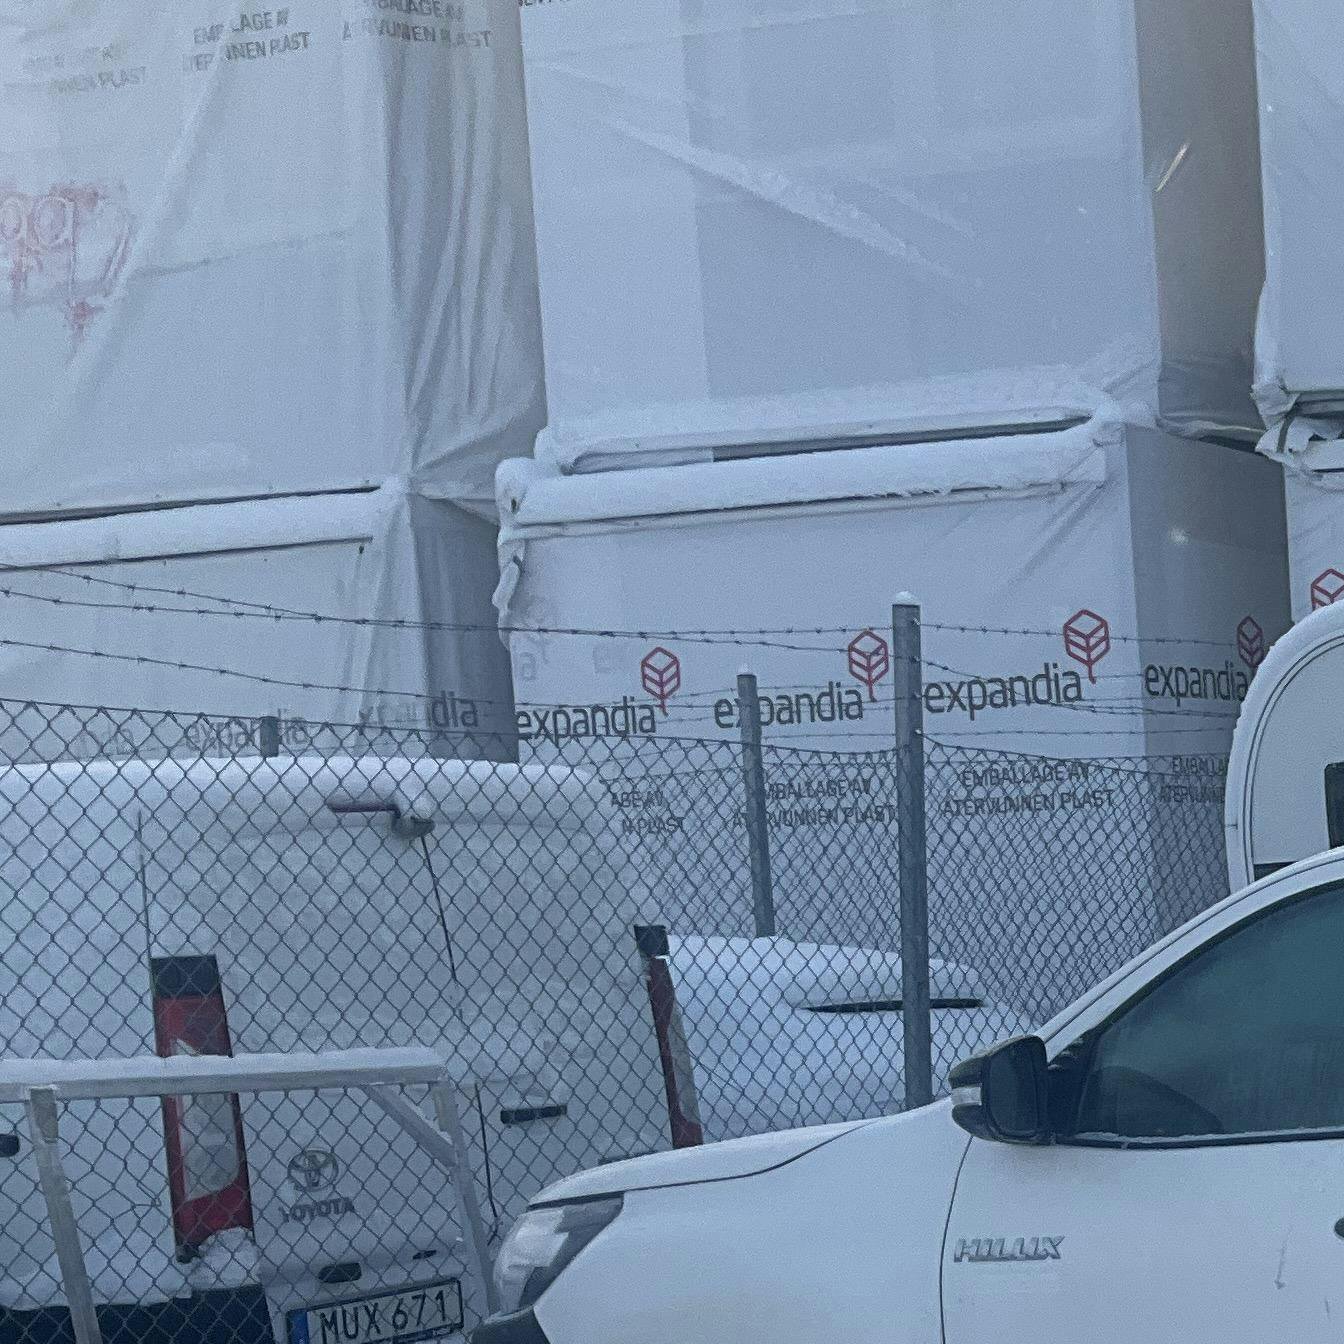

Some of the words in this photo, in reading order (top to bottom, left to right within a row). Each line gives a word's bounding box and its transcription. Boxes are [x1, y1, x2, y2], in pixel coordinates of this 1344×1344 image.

[714, 681, 864, 729] epandia
[924, 662, 1083, 721] expandia
[1144, 660, 1249, 707] expandia
[515, 696, 656, 748] expandia
[391, 1289, 447, 1331] 671
